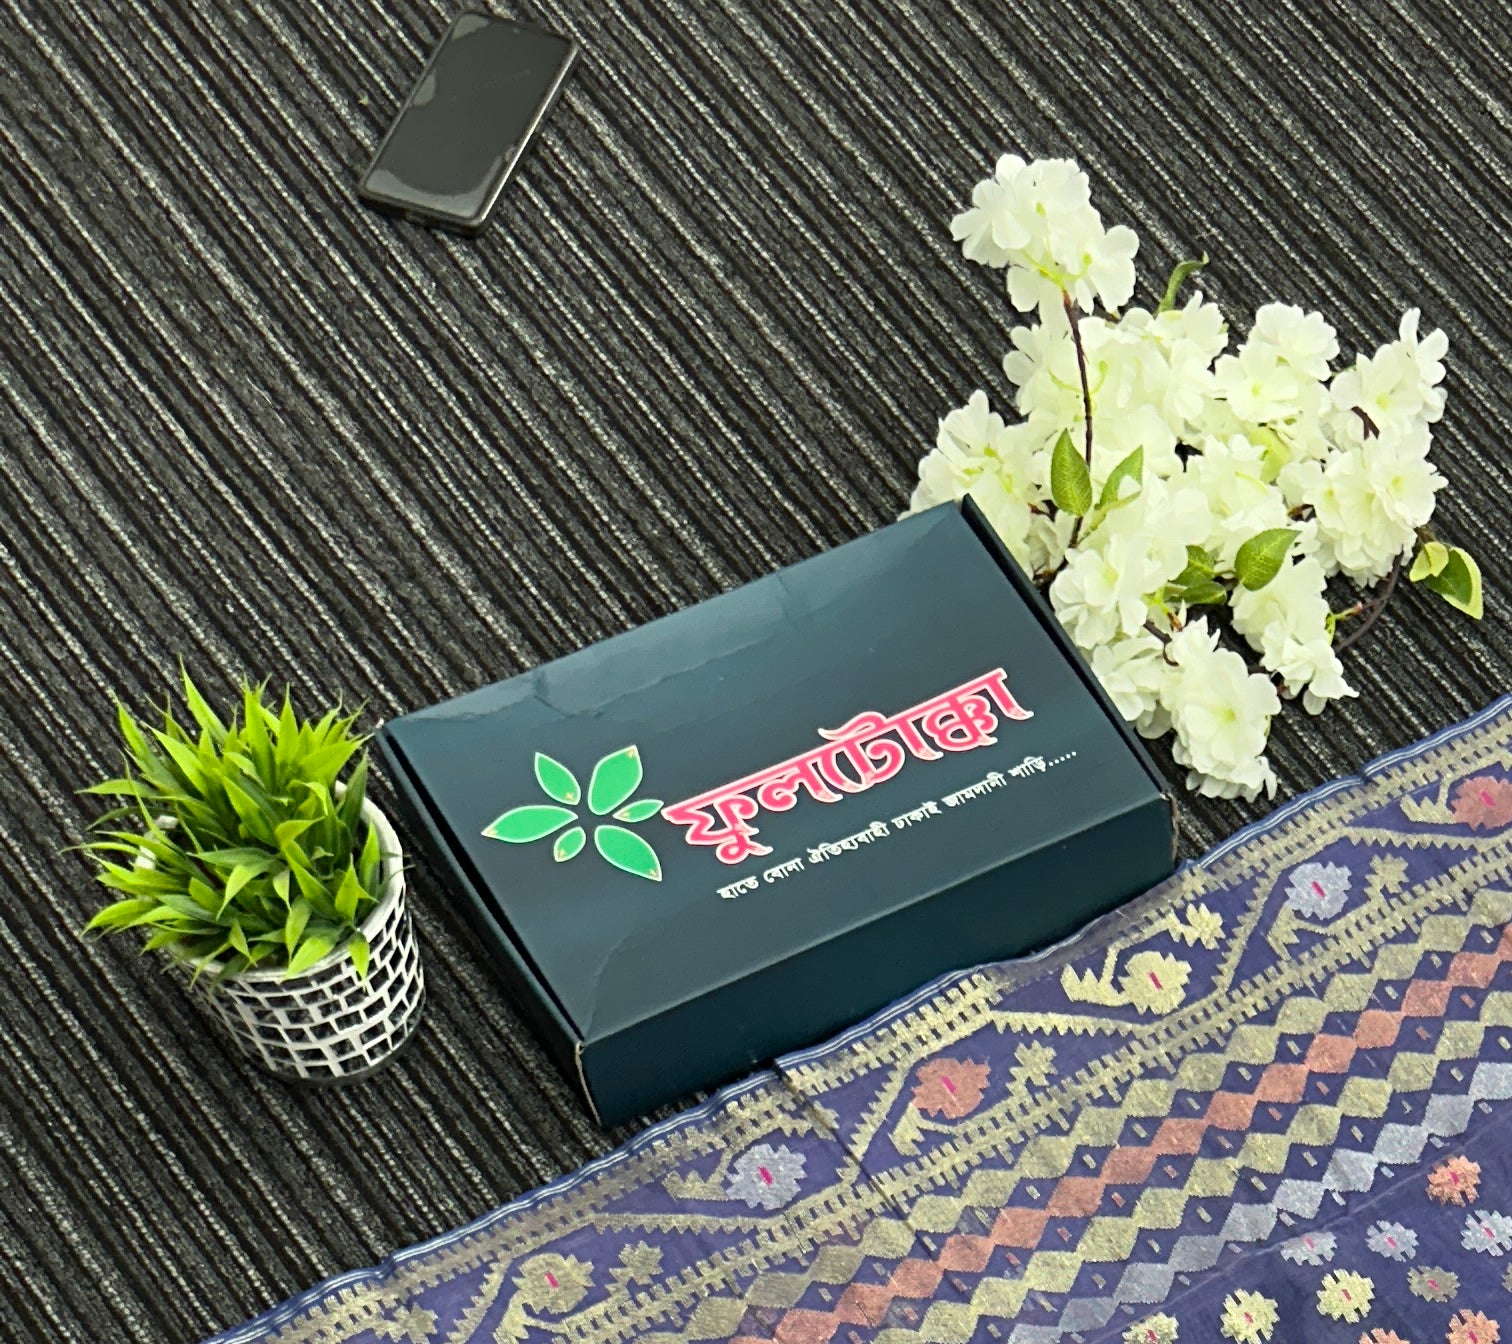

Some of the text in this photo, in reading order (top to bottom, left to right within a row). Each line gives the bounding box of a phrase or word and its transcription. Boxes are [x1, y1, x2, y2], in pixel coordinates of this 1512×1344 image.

[716, 875, 759, 899] হাতে
[763, 857, 805, 883] বোনা
[807, 821, 890, 864] ঐতিহ্যবাহী
[891, 801, 942, 829] ঢাকাই
[941, 772, 1007, 807] জামদানী
